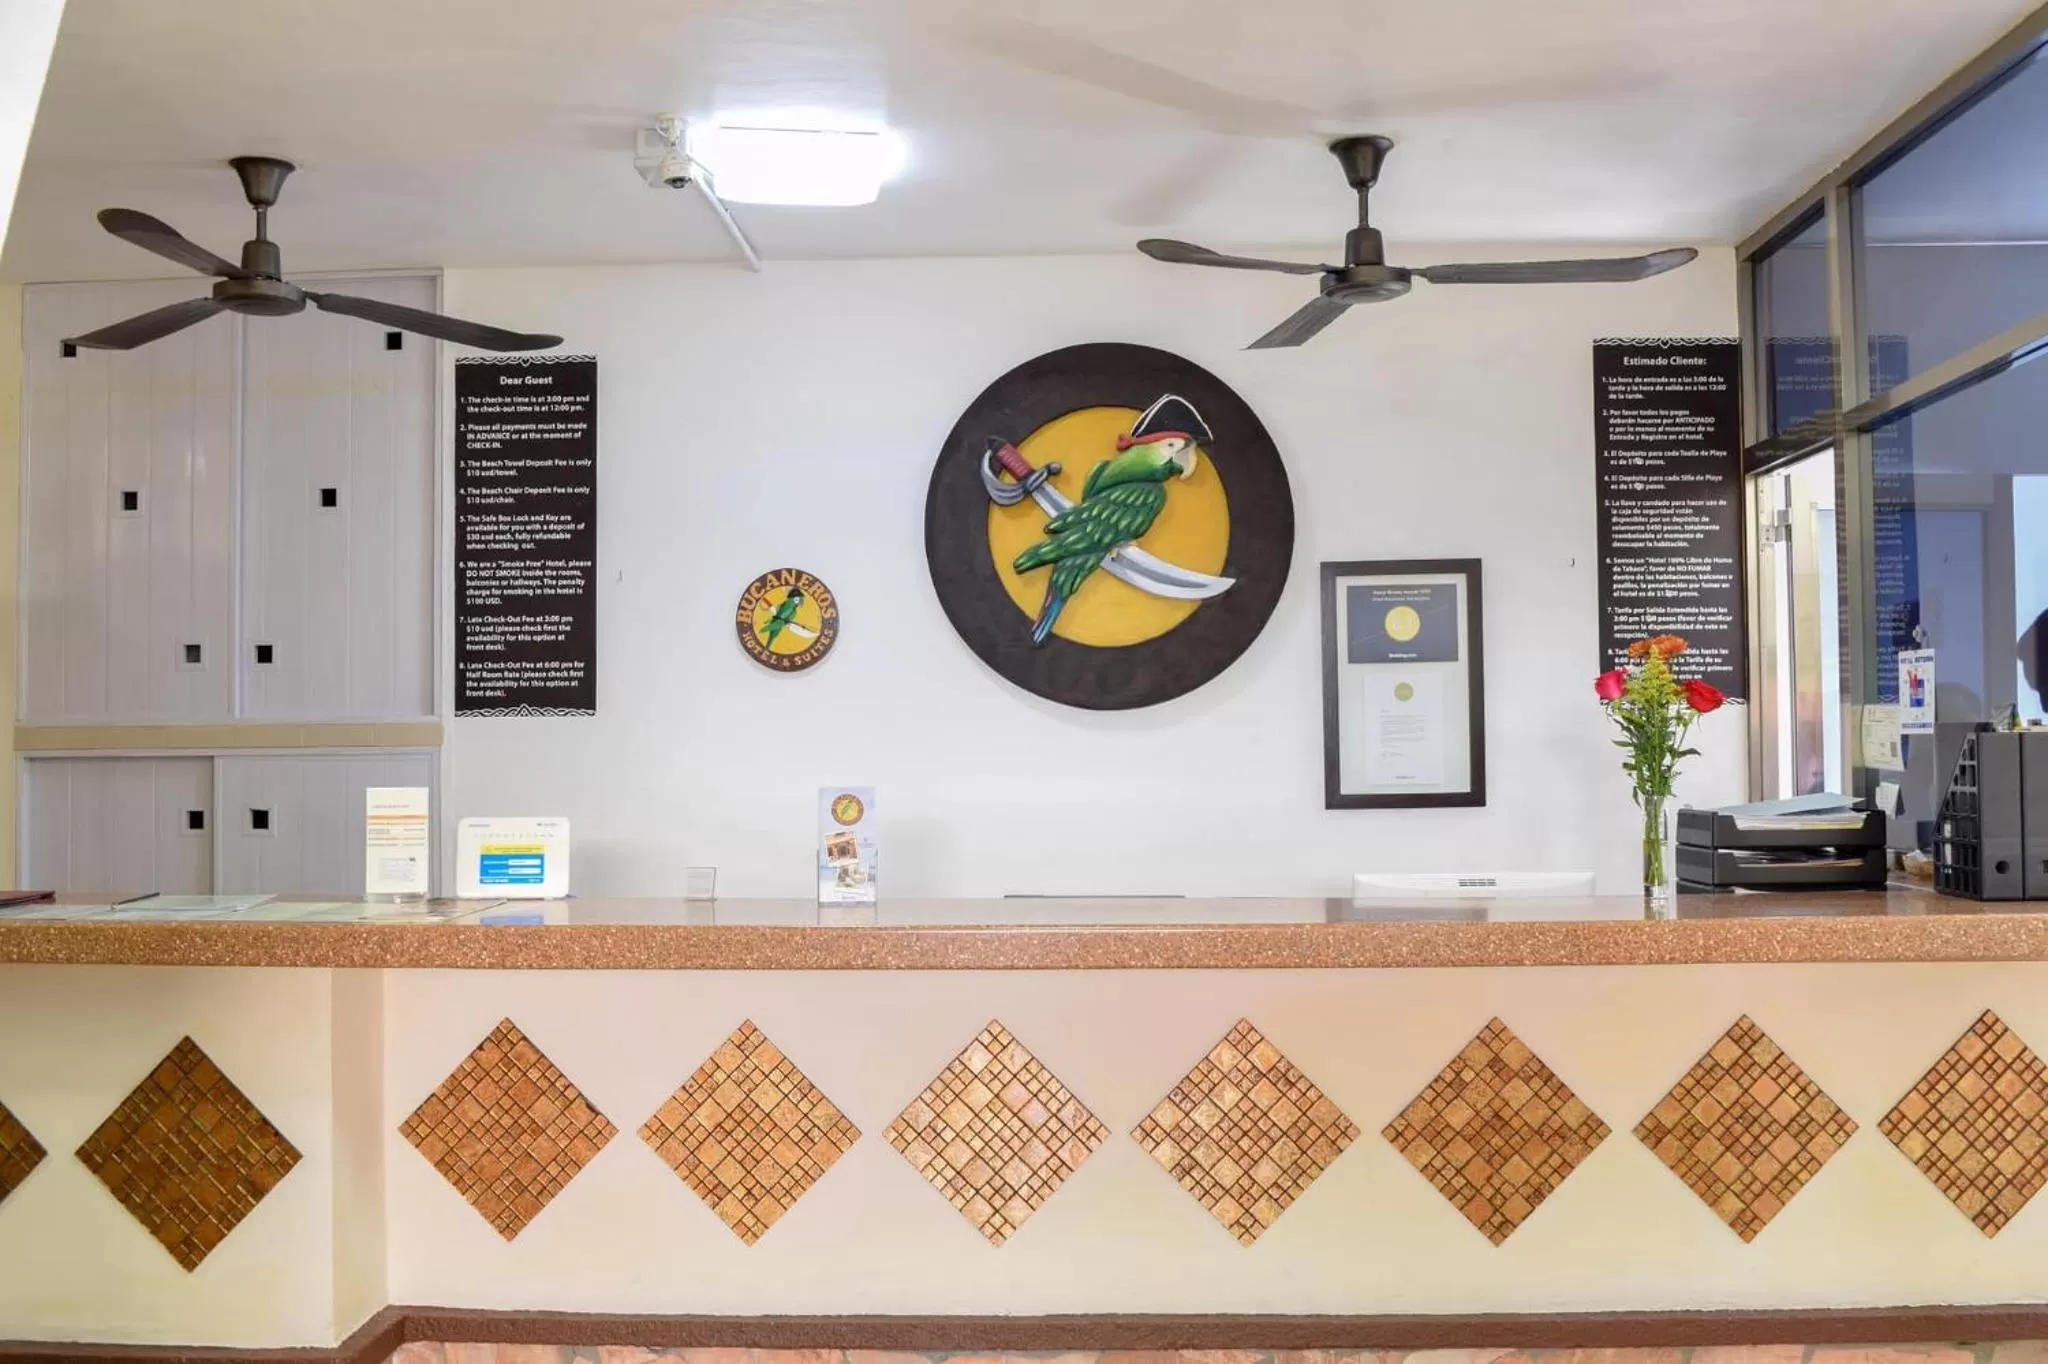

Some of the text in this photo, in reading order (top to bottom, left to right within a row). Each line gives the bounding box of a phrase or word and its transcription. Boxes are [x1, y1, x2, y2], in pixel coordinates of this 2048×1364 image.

[1623, 356, 1707, 365] Estimado Cliente:
[499, 376, 553, 384] Dear Guest
[737, 569, 837, 624] BUCANEROS
[742, 629, 834, 667] HOTEL & SUITES
